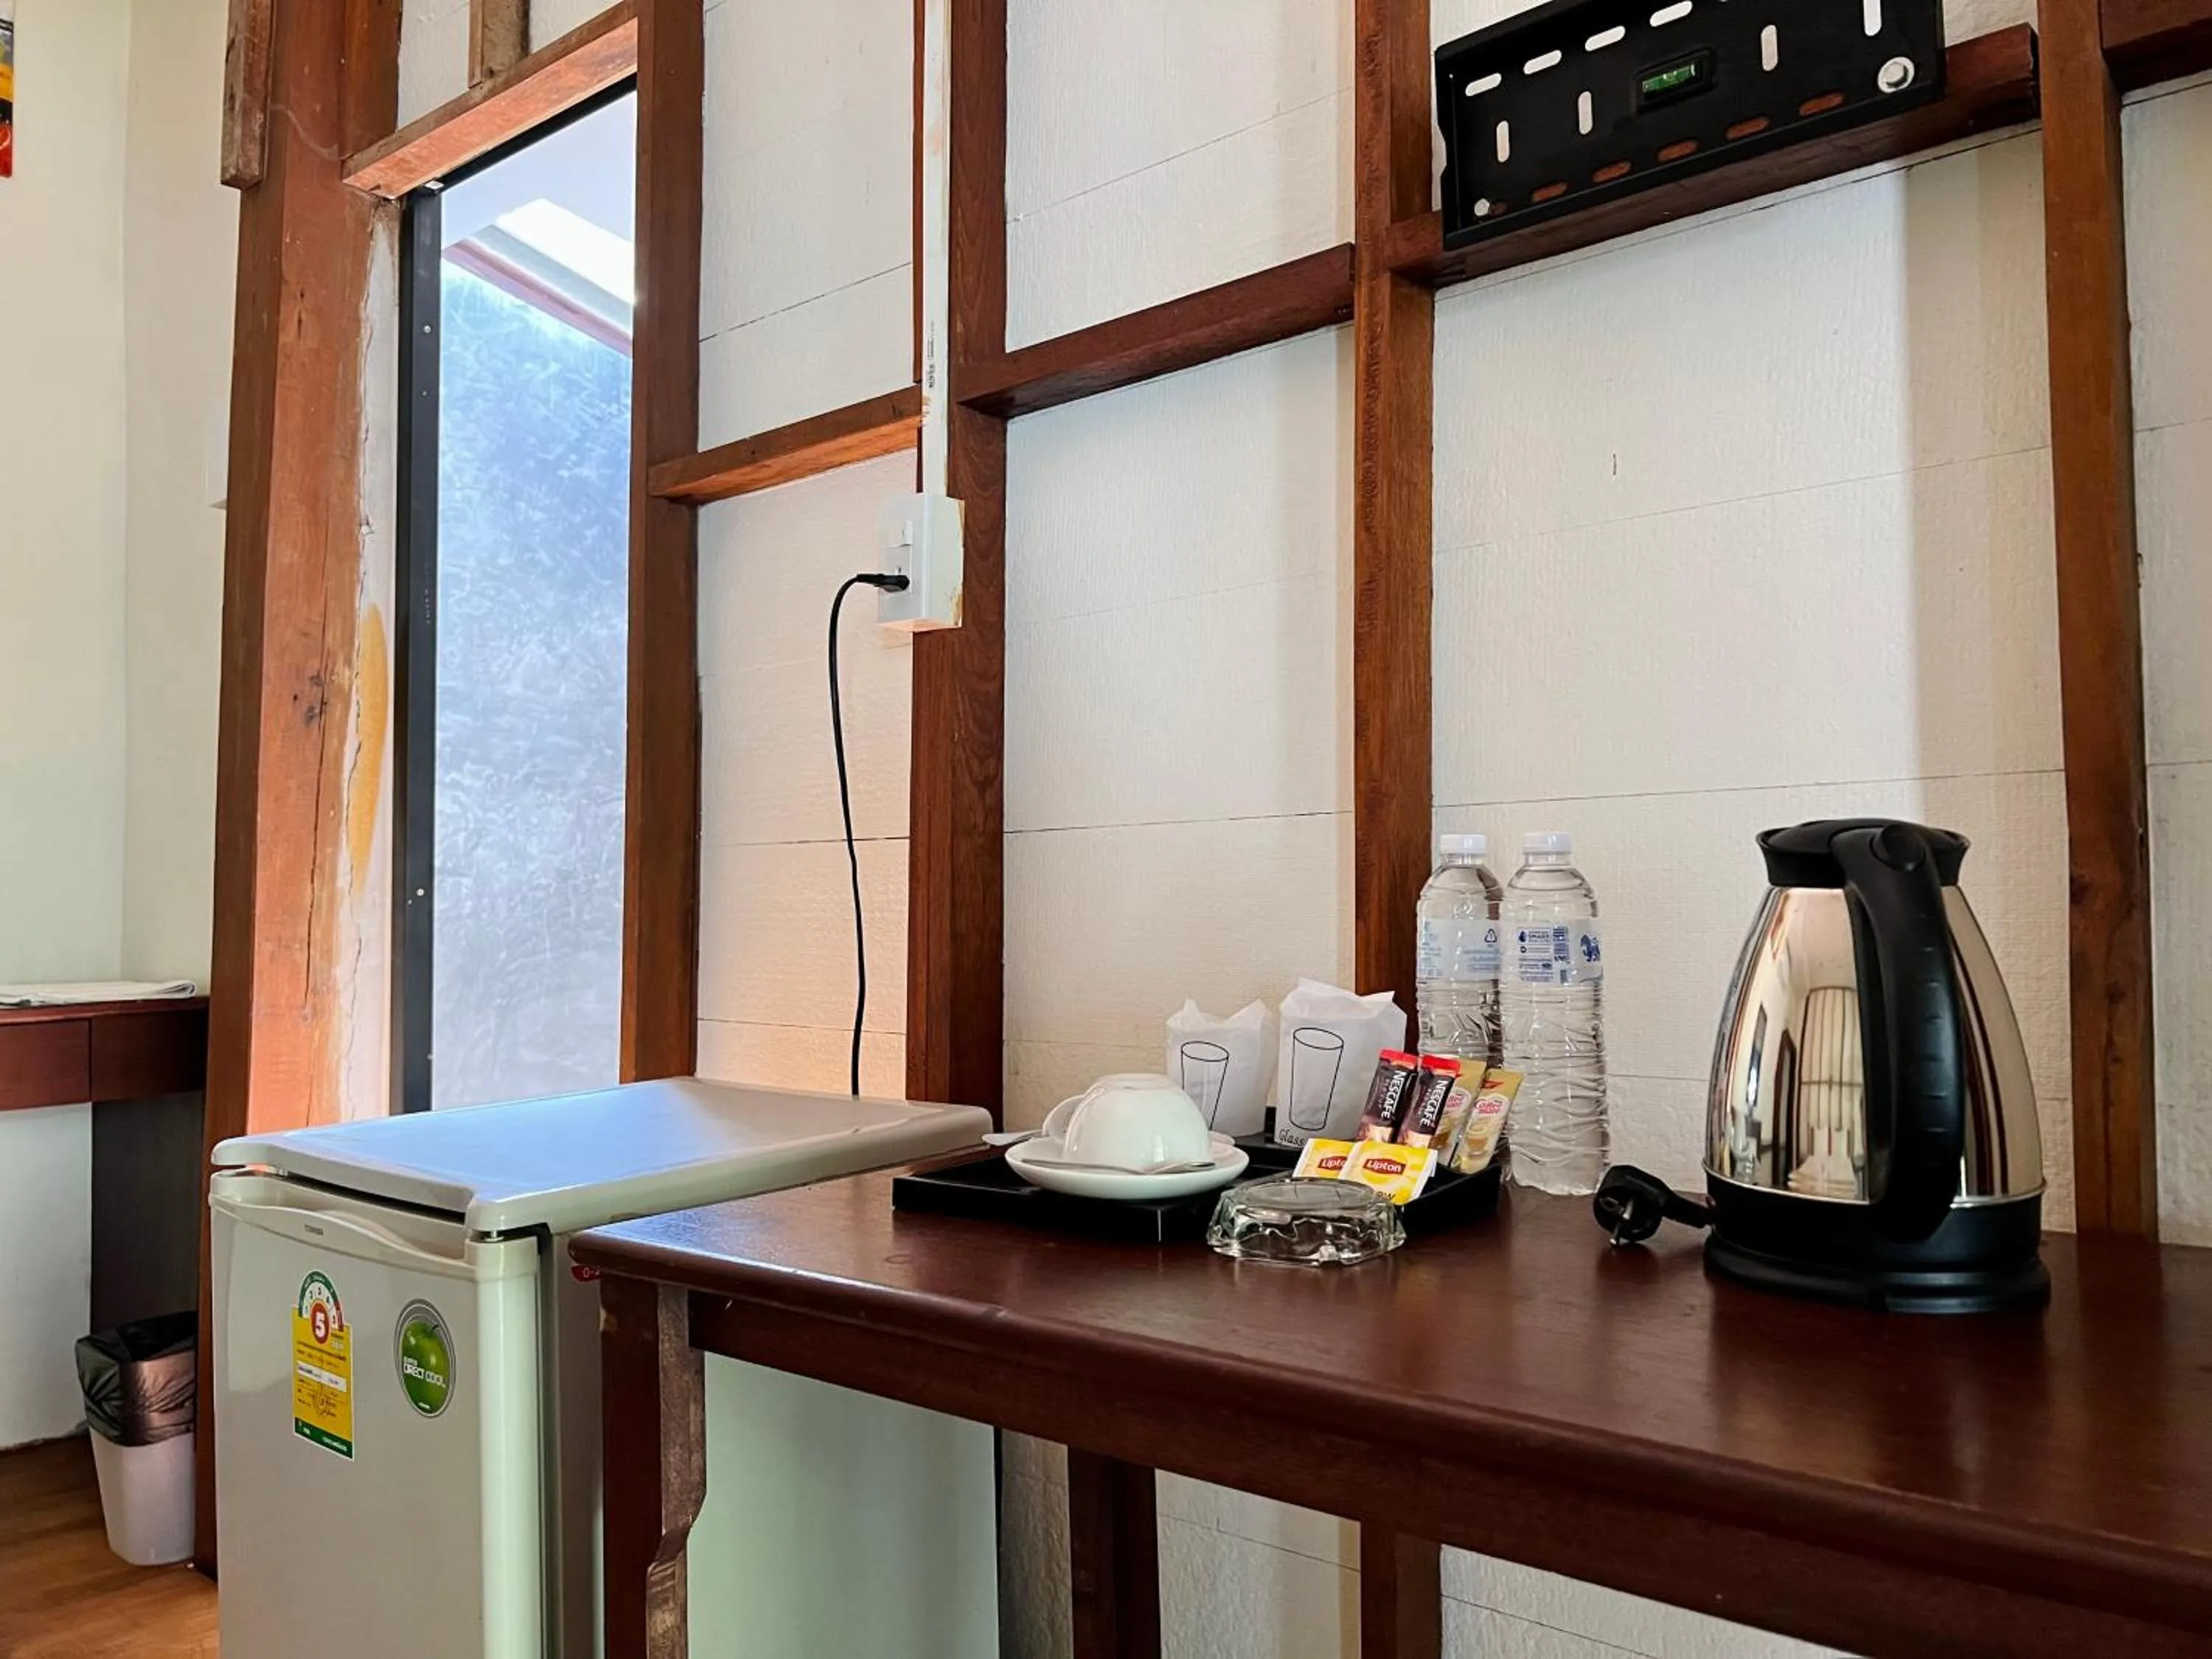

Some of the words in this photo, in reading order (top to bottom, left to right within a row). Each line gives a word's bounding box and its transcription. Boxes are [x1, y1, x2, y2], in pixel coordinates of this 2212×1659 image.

[1322, 1158, 1346, 1169] Lipto
[1367, 1160, 1402, 1172] Lipton
[315, 1312, 325, 1338] 5
